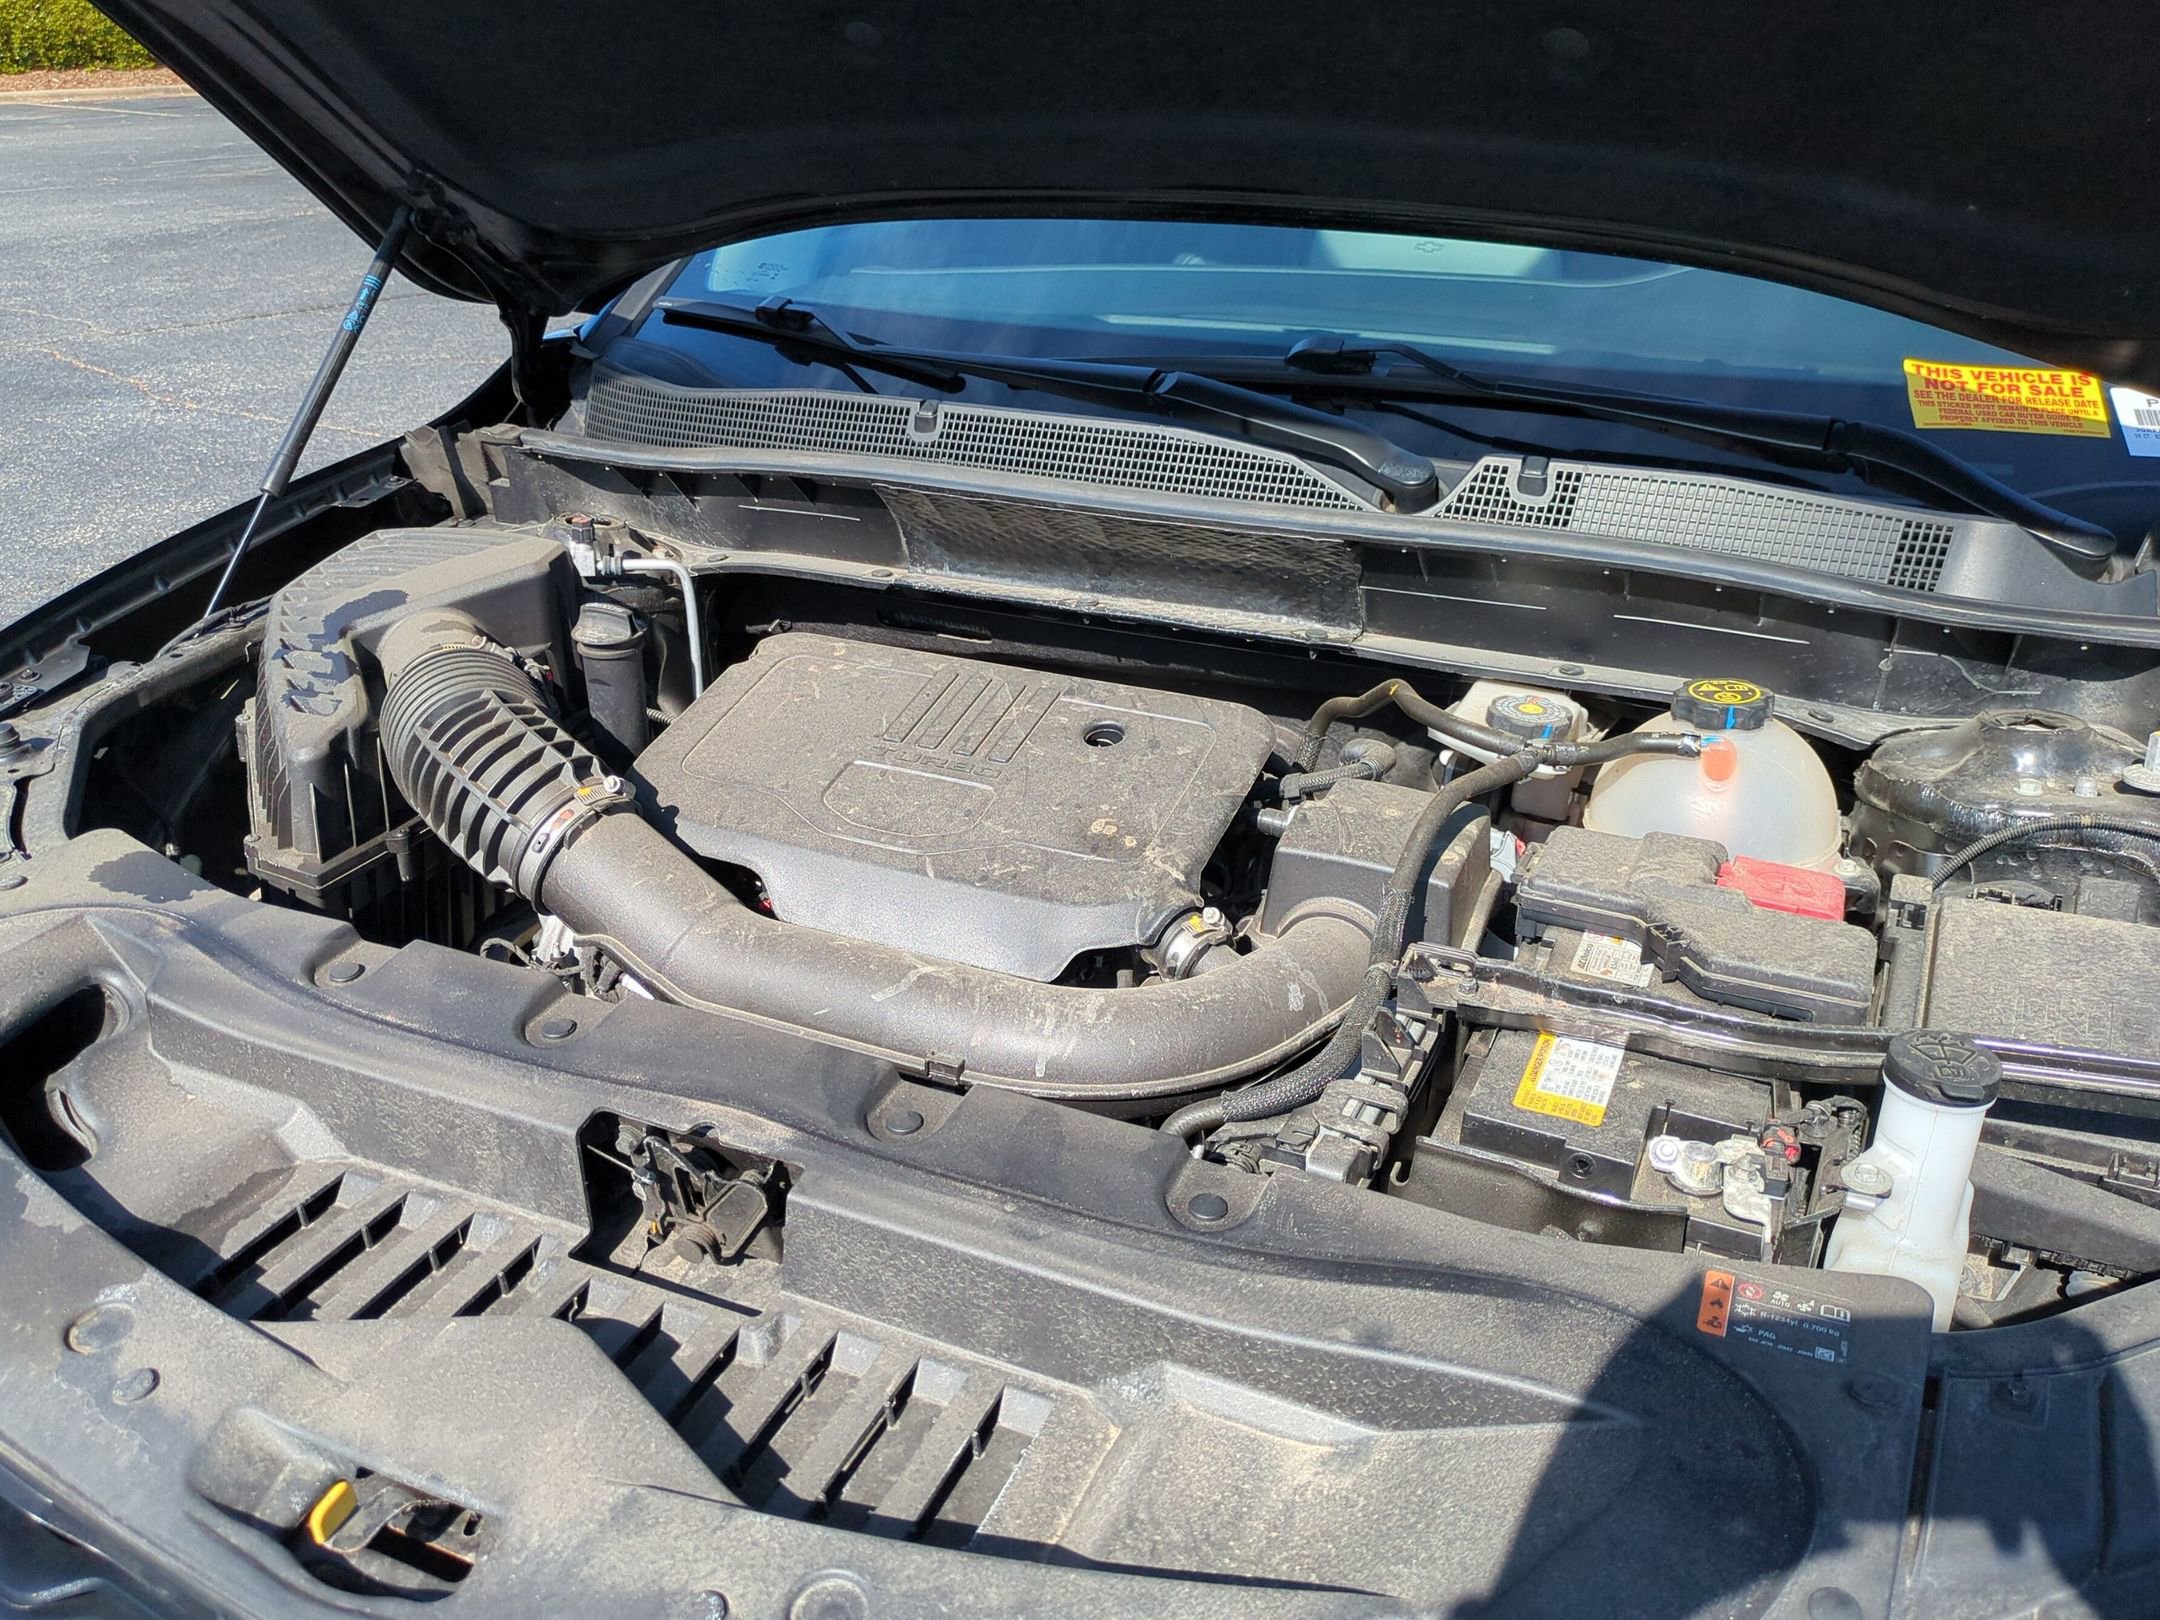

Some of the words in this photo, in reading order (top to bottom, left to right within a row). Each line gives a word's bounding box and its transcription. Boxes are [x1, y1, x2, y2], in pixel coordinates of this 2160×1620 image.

[1911, 363, 1962, 379] THIS
[1970, 370, 2064, 385] VEHICLE
[2070, 373, 2091, 386] IS
[1924, 378, 1968, 392] NOT
[1976, 382, 2021, 395] FOR
[2029, 384, 2085, 398] SALE
[1913, 390, 1933, 399] SEE
[1934, 391, 1957, 400] THE
[1958, 393, 1999, 403] DEALER
[2001, 396, 2022, 405] FOR
[2025, 397, 2072, 407] RELEASE
[2074, 400, 2100, 409] DATE
[1937, 401, 1972, 409] STICKER
[1997, 404, 2029, 412] REMAIN
[1938, 407, 1975, 416] FEDERAL
[2046, 413, 2072, 421] GUIDE
[1981, 416, 2014, 425] AFFIXED
[2049, 420, 2084, 428] VEHICLE
[871, 746, 1002, 779] TURBO
[1770, 1299, 1790, 1308] AUTO
